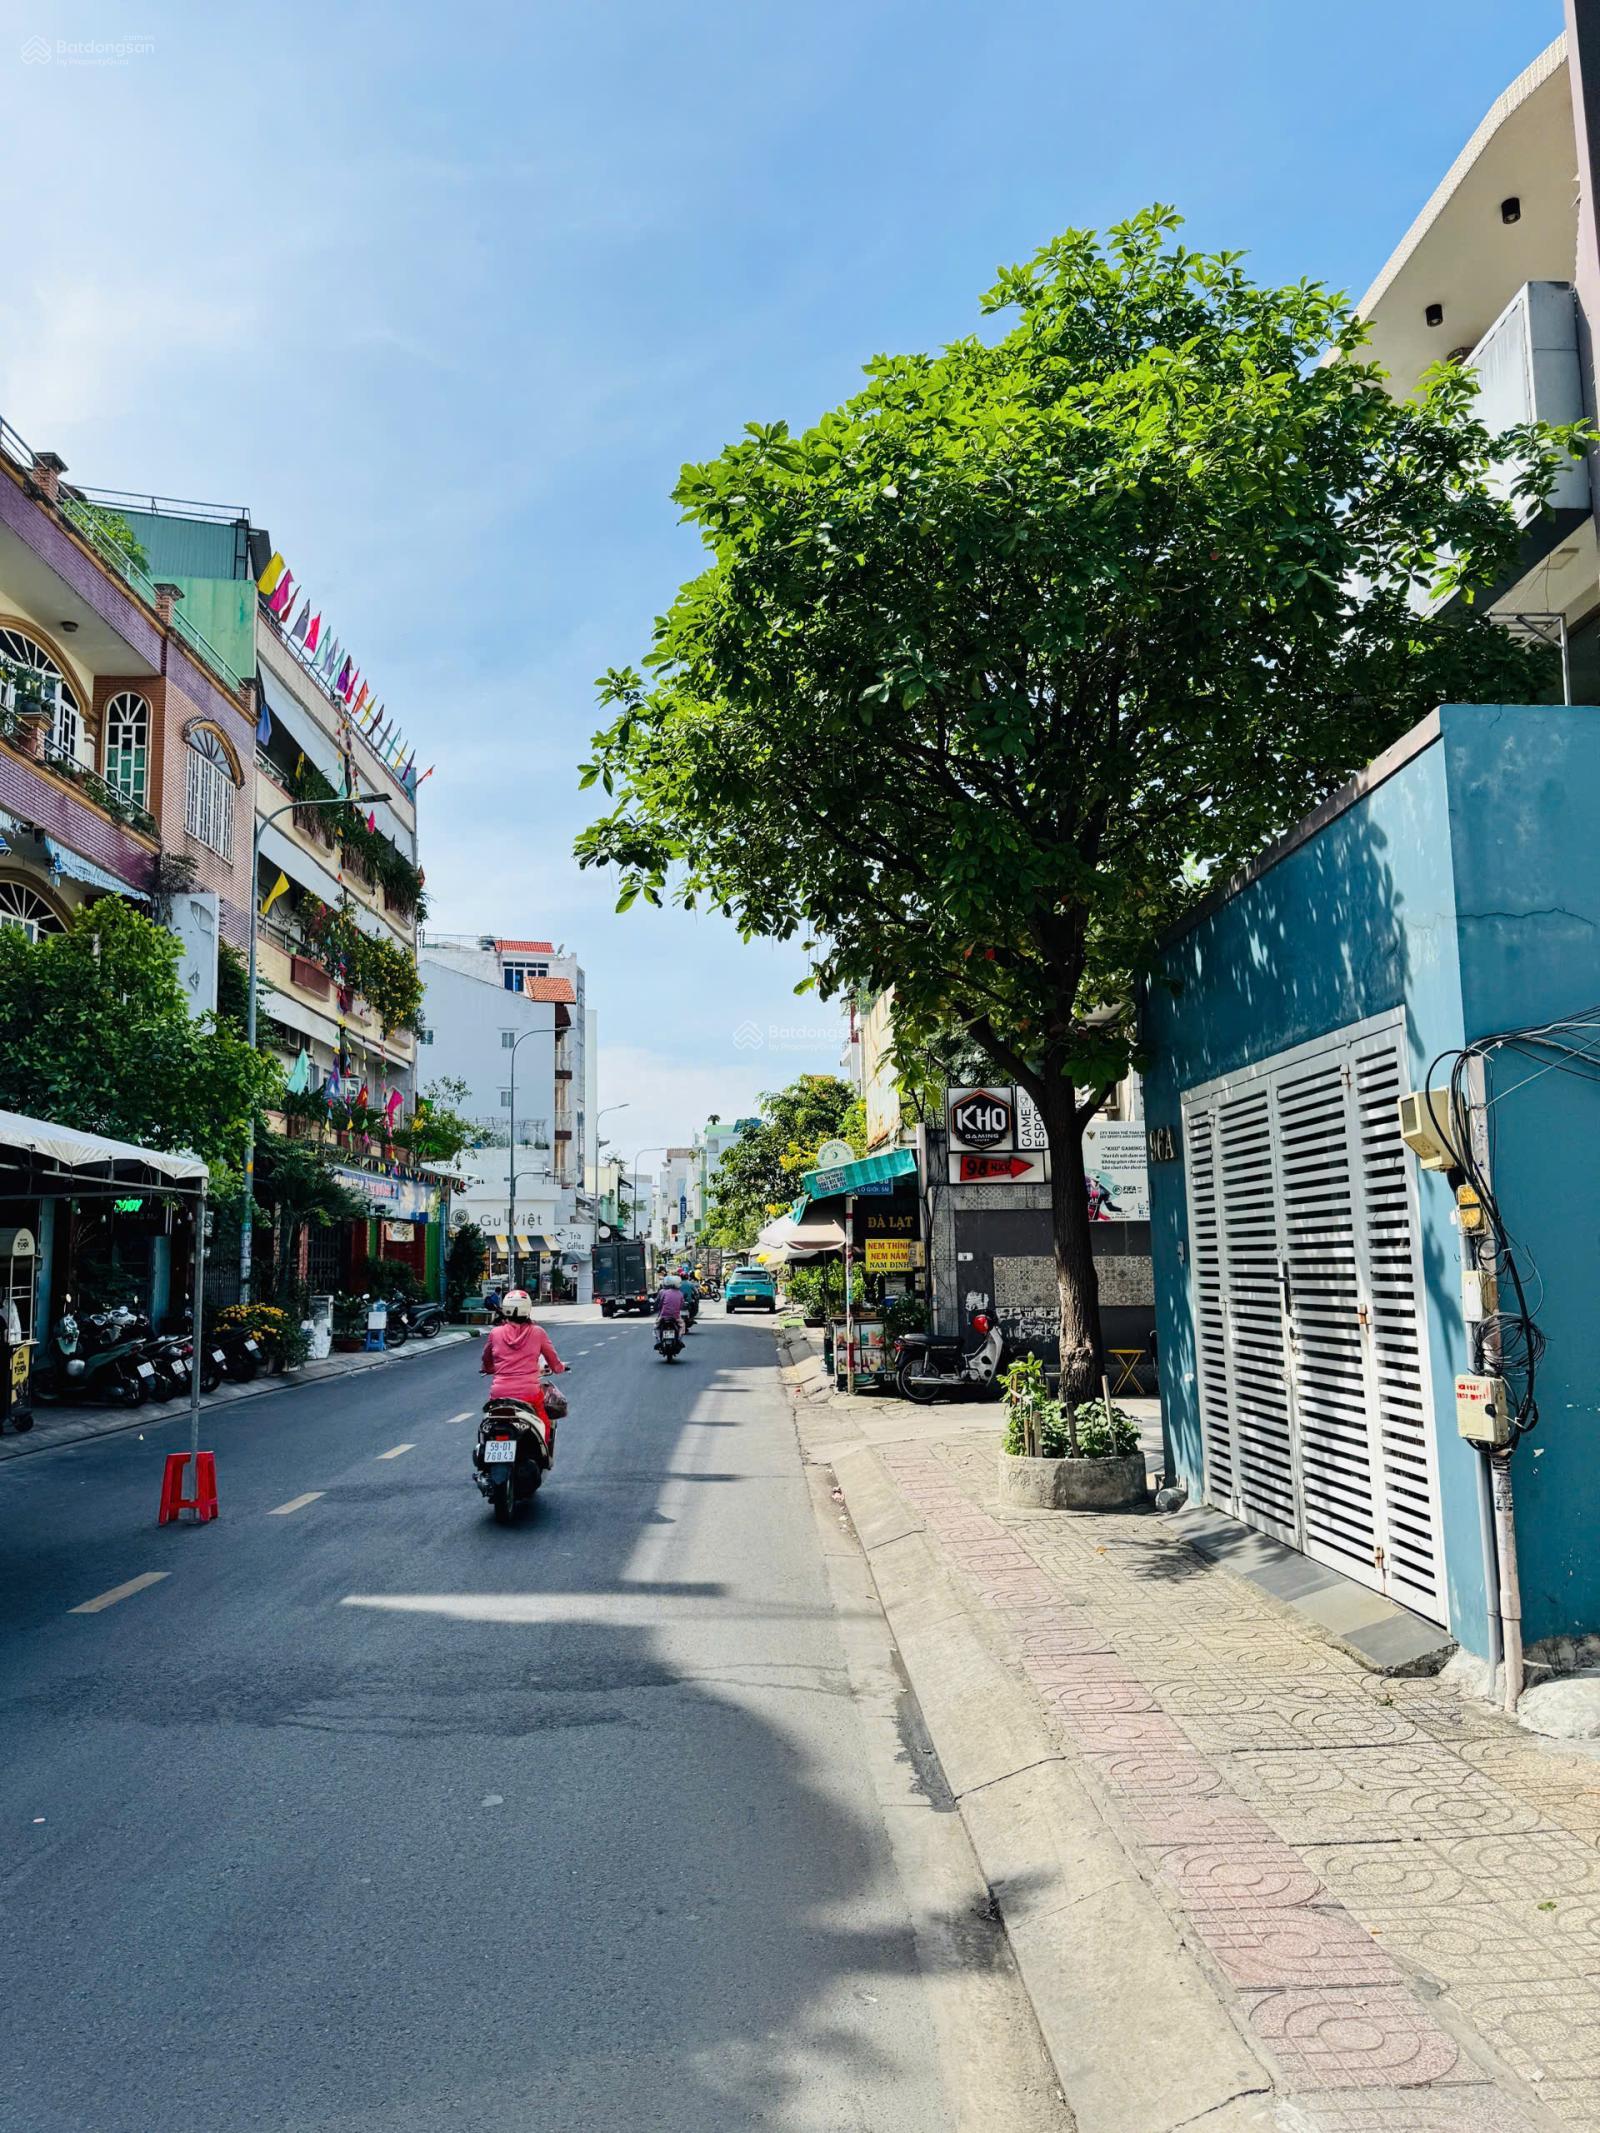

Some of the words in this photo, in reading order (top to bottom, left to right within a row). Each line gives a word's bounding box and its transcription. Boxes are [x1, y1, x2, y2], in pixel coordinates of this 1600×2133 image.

[956, 1105, 1006, 1131] KHO
[1021, 1108, 1032, 1147] GAME
[1150, 1125, 1175, 1161] 96A
[480, 1214, 501, 1227] Gu
[868, 1214, 886, 1228] ĐÀ
[888, 1216, 913, 1231] LẠT
[868, 1241, 885, 1250] NEM
[870, 1252, 888, 1260] NEM
